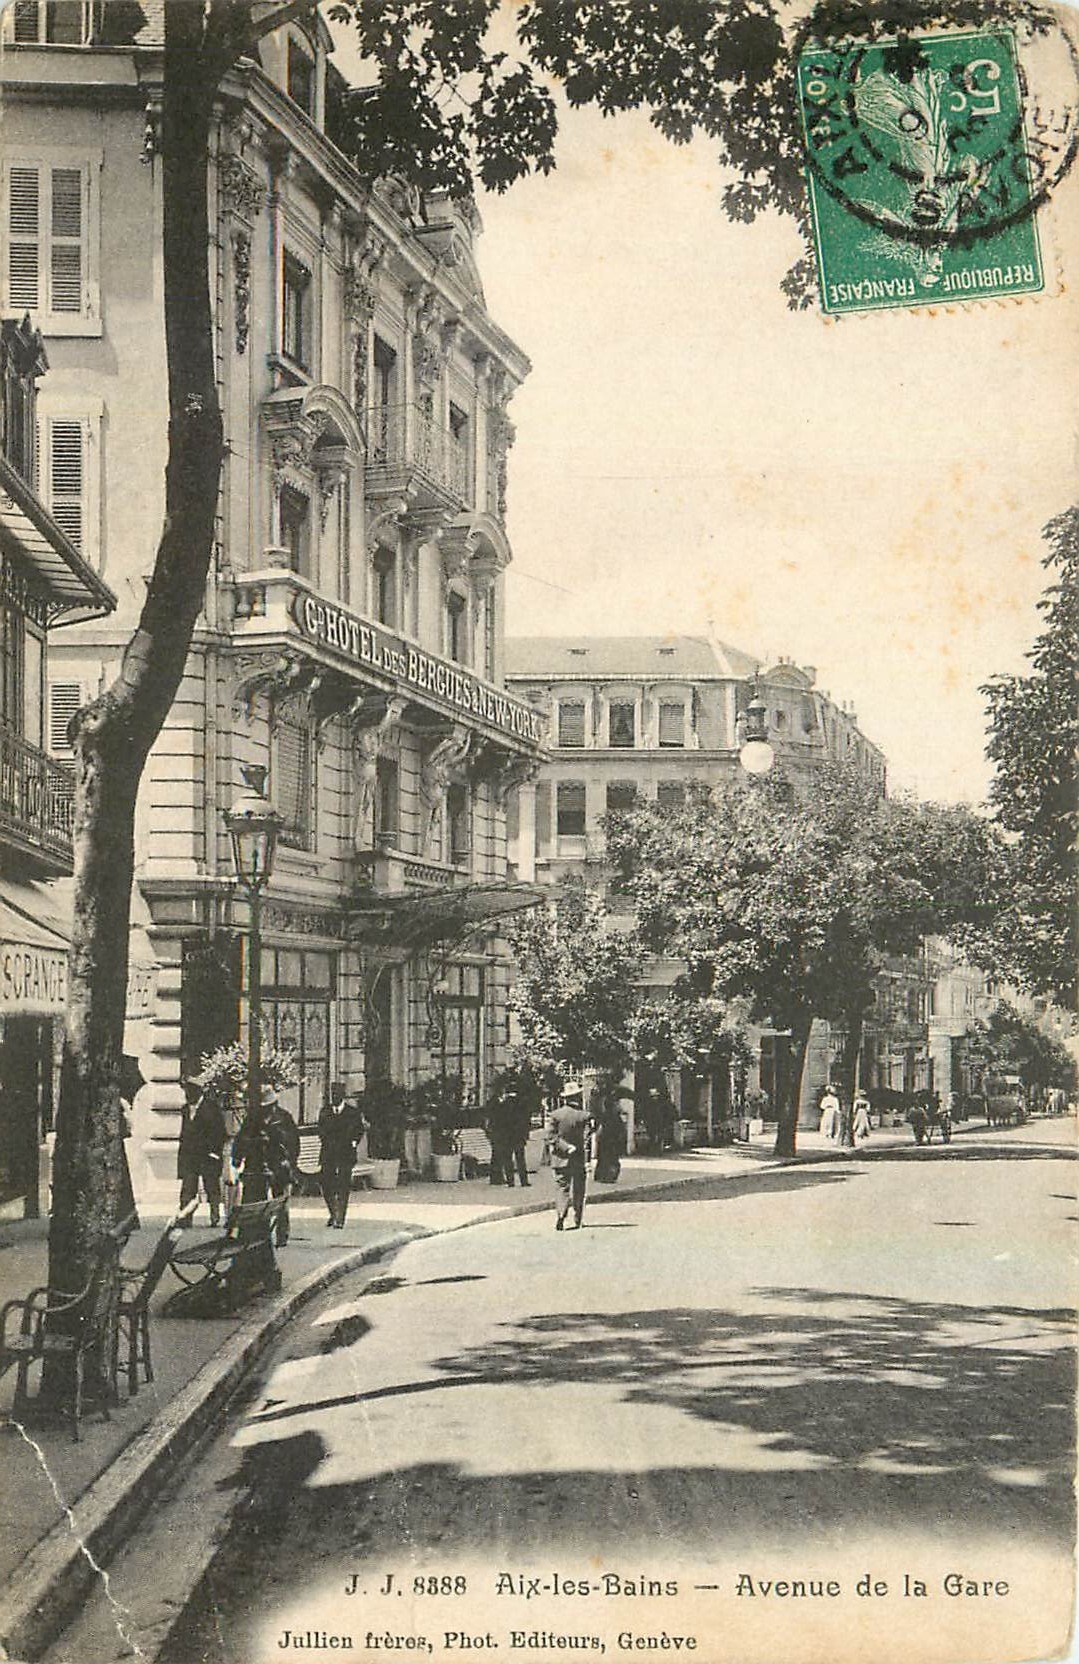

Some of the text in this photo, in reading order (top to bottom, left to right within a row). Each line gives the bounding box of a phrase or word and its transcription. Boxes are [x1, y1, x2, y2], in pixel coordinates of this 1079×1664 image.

[831, 277, 916, 304] FRANÇAISE
[383, 647, 406, 677] DES
[408, 649, 471, 710] BERGUES
[479, 685, 540, 742] NEW-YORK
